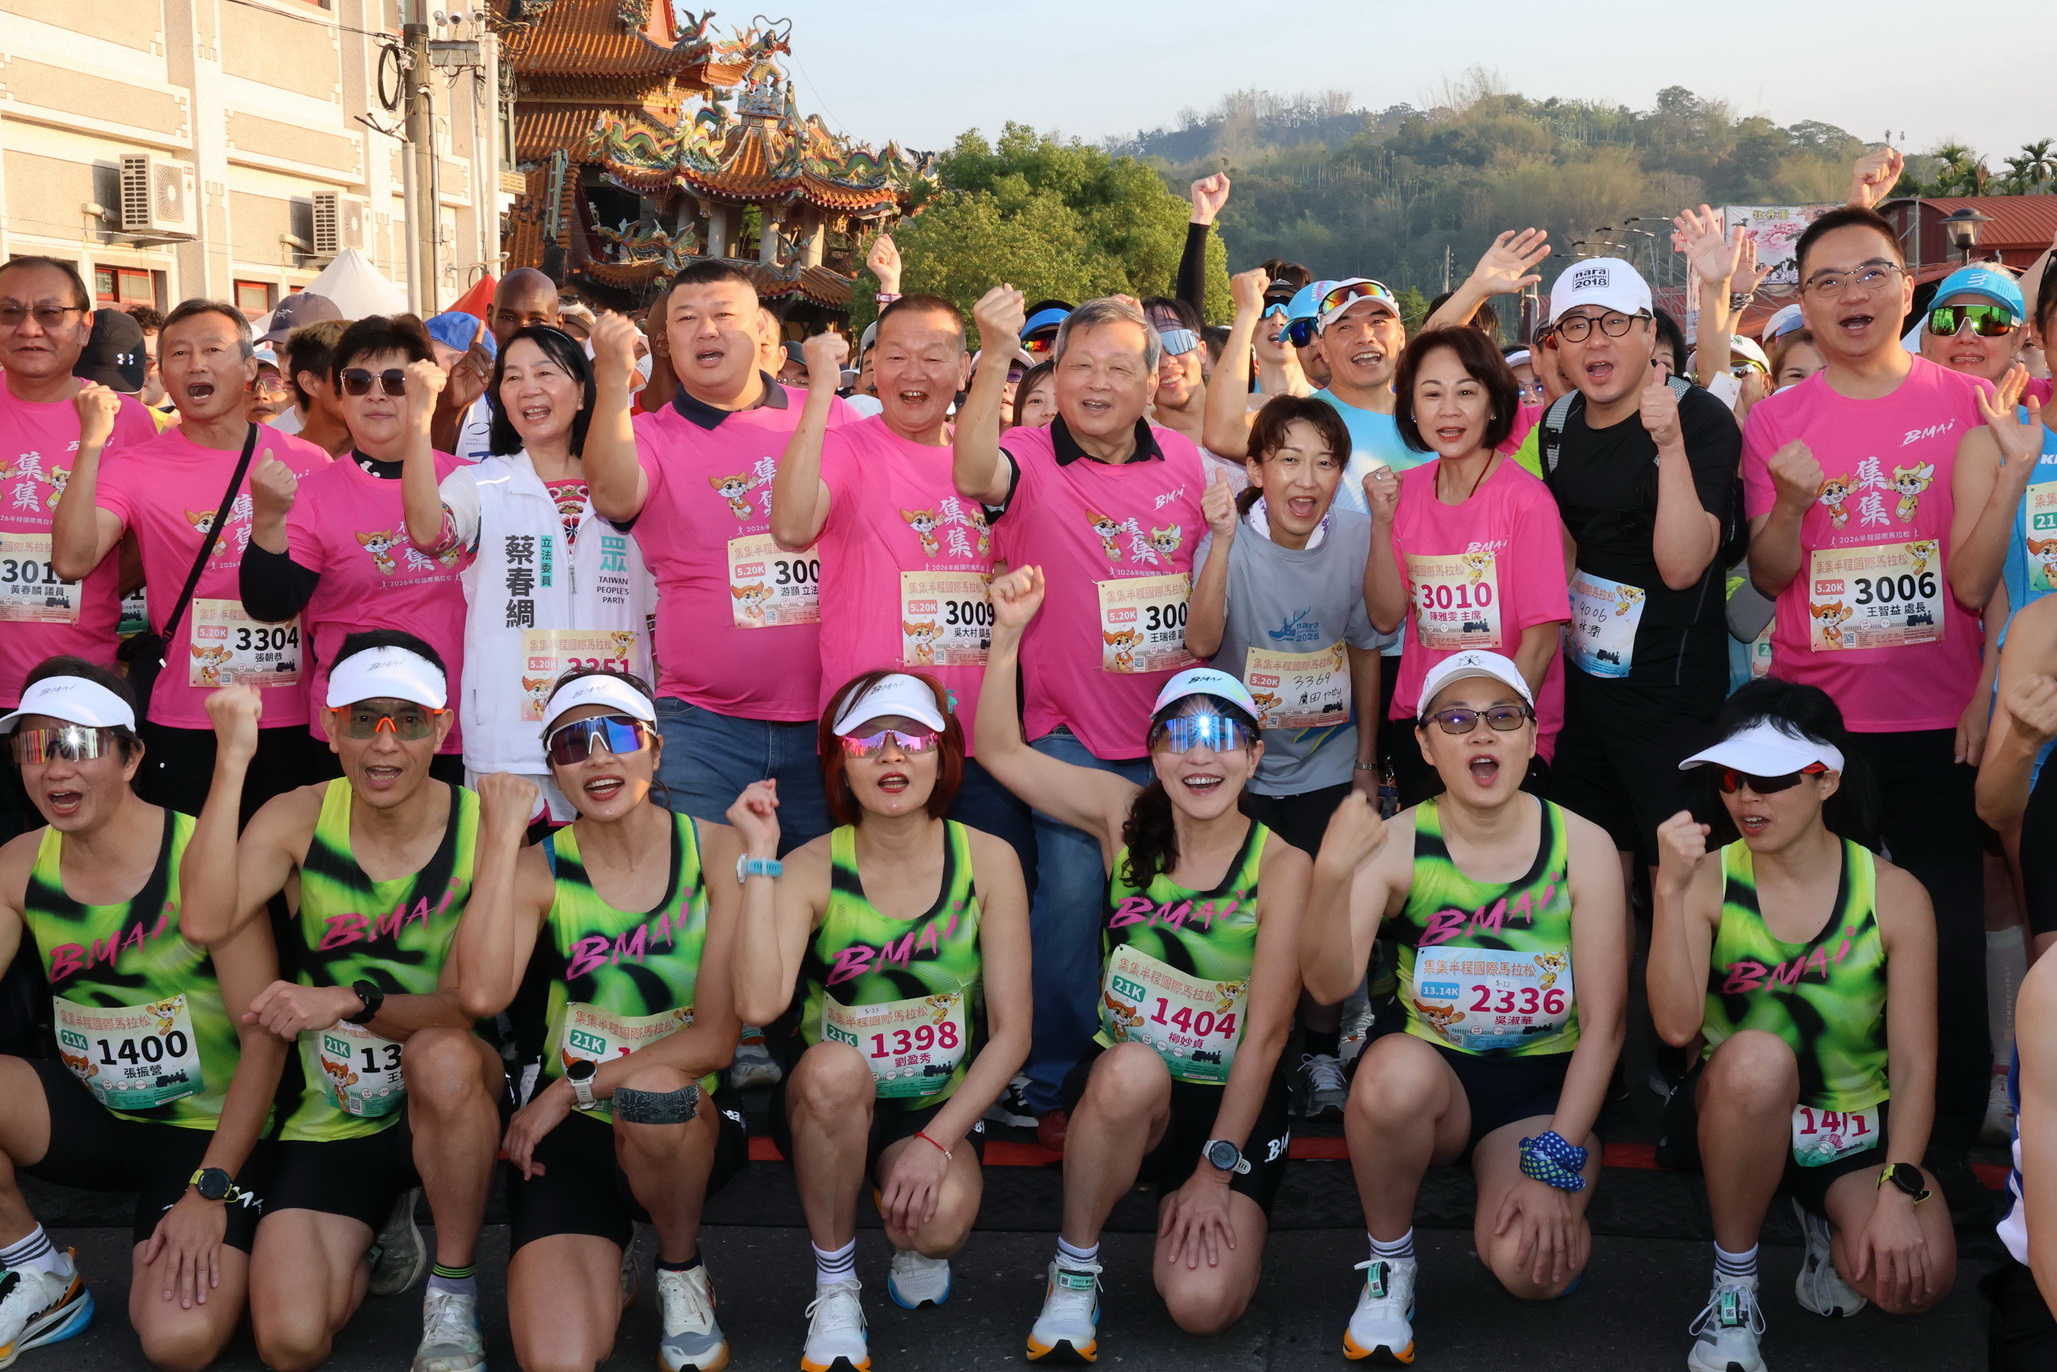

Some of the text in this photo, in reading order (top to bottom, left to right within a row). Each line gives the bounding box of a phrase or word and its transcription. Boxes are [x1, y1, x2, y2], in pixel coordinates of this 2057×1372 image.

[1576, 269, 1606, 278] nara
[1575, 278, 1607, 290] 2018
[1854, 456, 1891, 528] 集集
[938, 496, 973, 559] 集集
[541, 536, 552, 587] 立法委員
[1816, 554, 1909, 574] 集集半程國際馬拉松
[737, 566, 765, 577] 5.20K
[596, 585, 630, 595] PEOPLE'S
[598, 576, 629, 586] TAIWAN
[1816, 583, 1844, 593] 5.20K
[1854, 571, 1937, 605] 3006
[45, 586, 65, 597] 議員
[602, 596, 625, 605] PARTY
[1420, 581, 1493, 610] 3010
[910, 603, 937, 612] 5.20K
[1109, 611, 1137, 622] 5.20K
[1461, 610, 1482, 621] 主席
[1866, 602, 1926, 618] 王智益 處長
[199, 629, 228, 639] 5.20K
[1296, 620, 1319, 630] nara
[235, 626, 300, 652] 3304
[1295, 633, 1320, 642] 2025
[1251, 676, 1278, 687] 5.20K
[1293, 672, 1332, 690] 3369
[1424, 959, 1536, 978] 集集半程國際馬拉松
[1118, 957, 1216, 1003] 集集半程國際馬拉松
[1114, 978, 1143, 1001] 21K
[1423, 986, 1459, 996] 13.14K
[1469, 984, 1565, 1015] 2336
[575, 1010, 676, 1040] 集集半程國際馬拉松
[1150, 997, 1237, 1040] 1404
[62, 1032, 87, 1050] 21K
[97, 1030, 188, 1066] 1400
[325, 1037, 349, 1056] 21K
[572, 1032, 604, 1053] 21K
[870, 1022, 959, 1059] 1398
[1168, 1031, 1204, 1050] 柳妙貞
